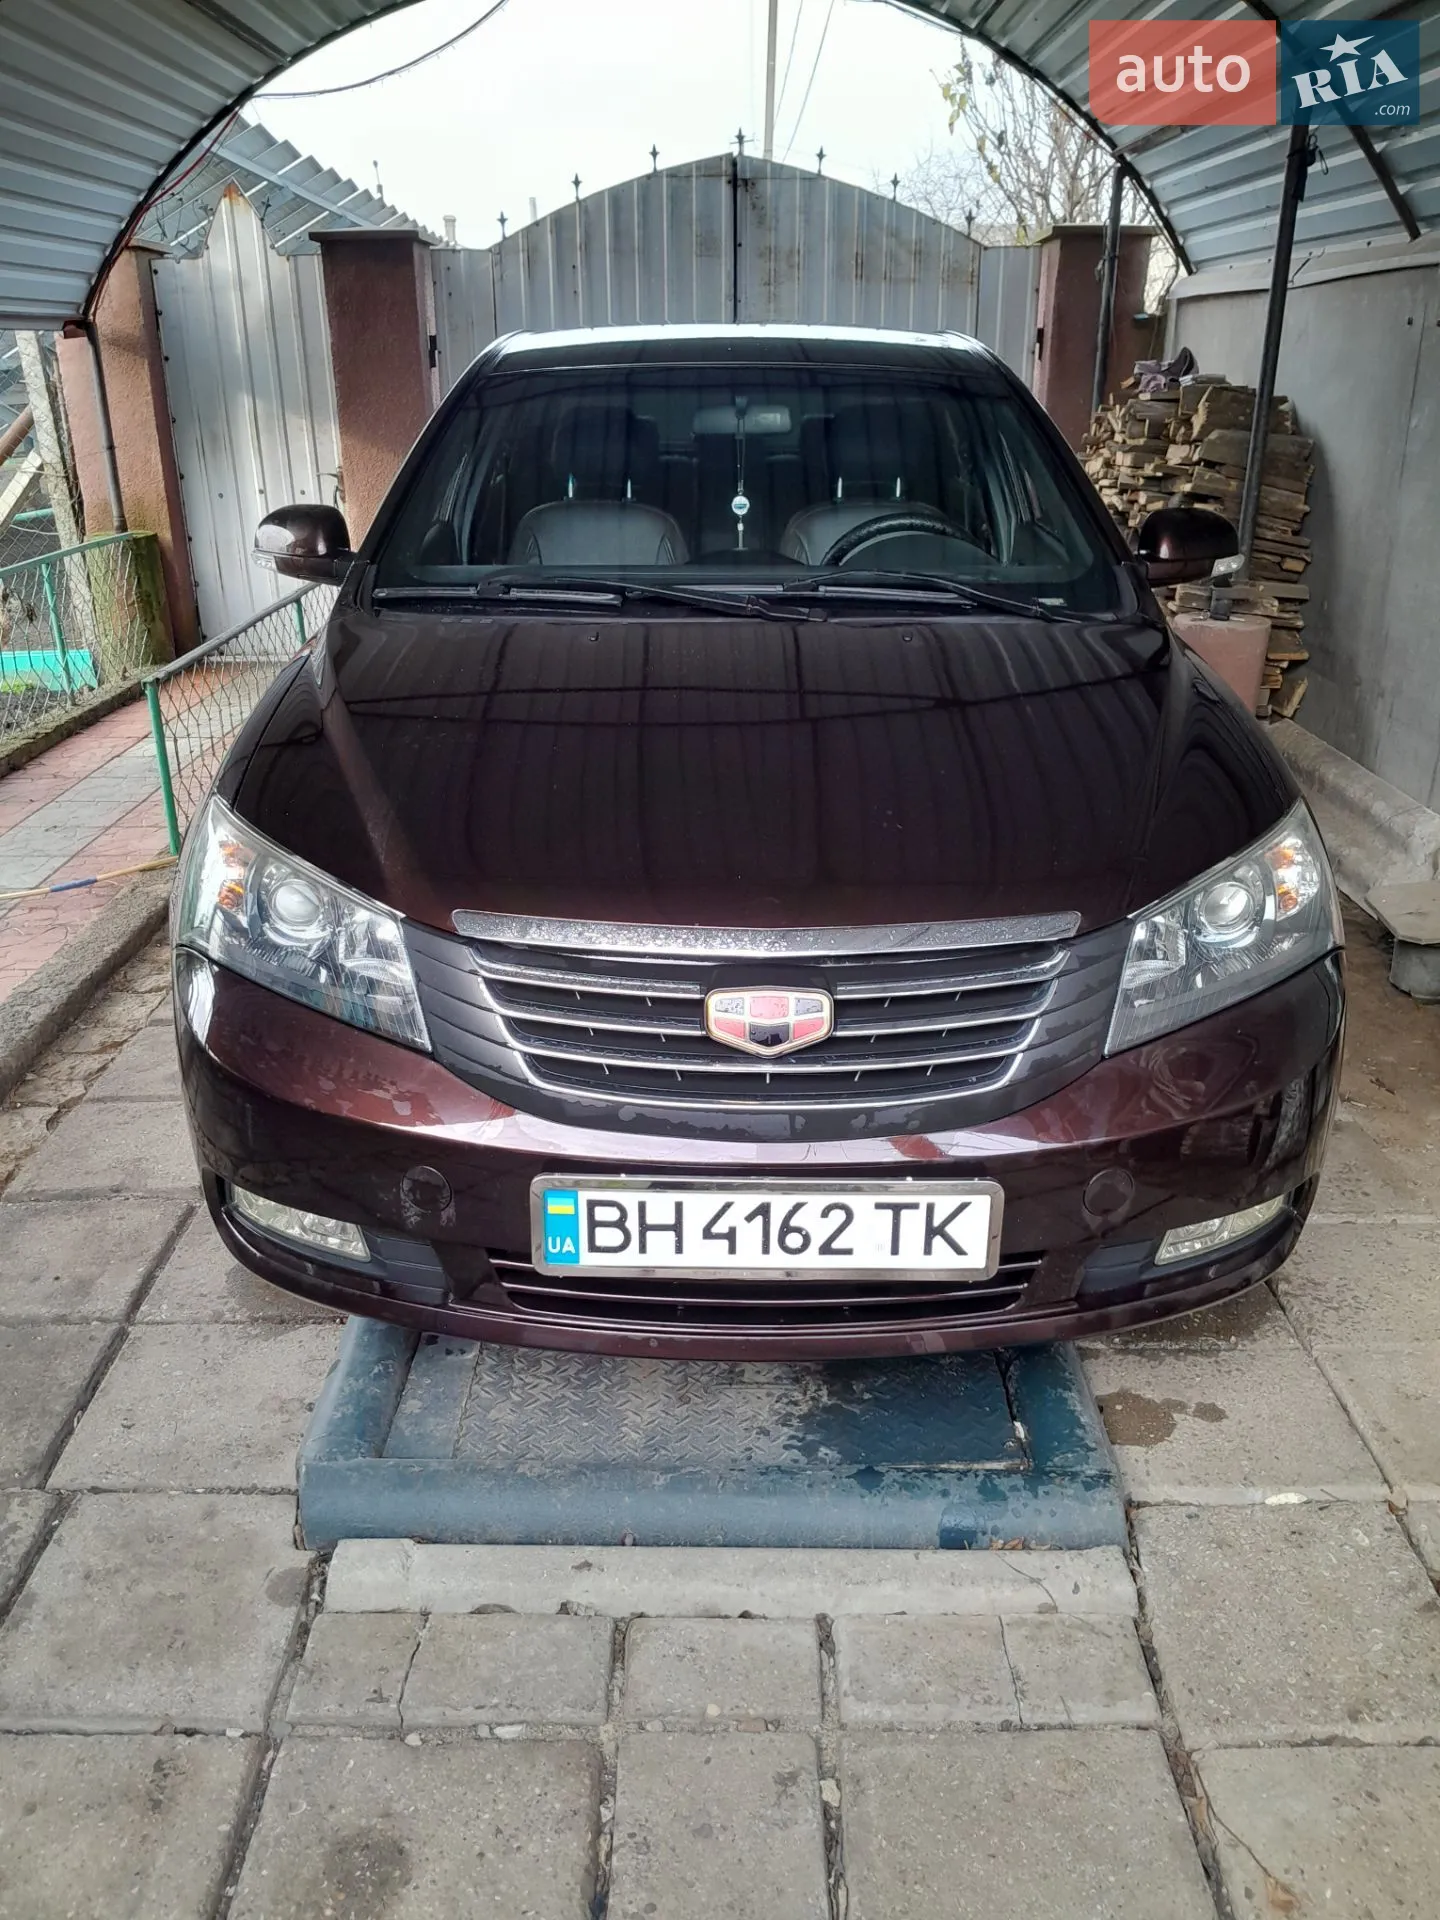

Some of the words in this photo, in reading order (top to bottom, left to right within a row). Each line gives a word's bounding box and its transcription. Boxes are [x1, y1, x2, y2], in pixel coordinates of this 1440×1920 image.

[547, 1236, 576, 1254] UA
[586, 1199, 684, 1255] BH
[702, 1201, 854, 1256] 4162
[874, 1201, 973, 1256] TK
